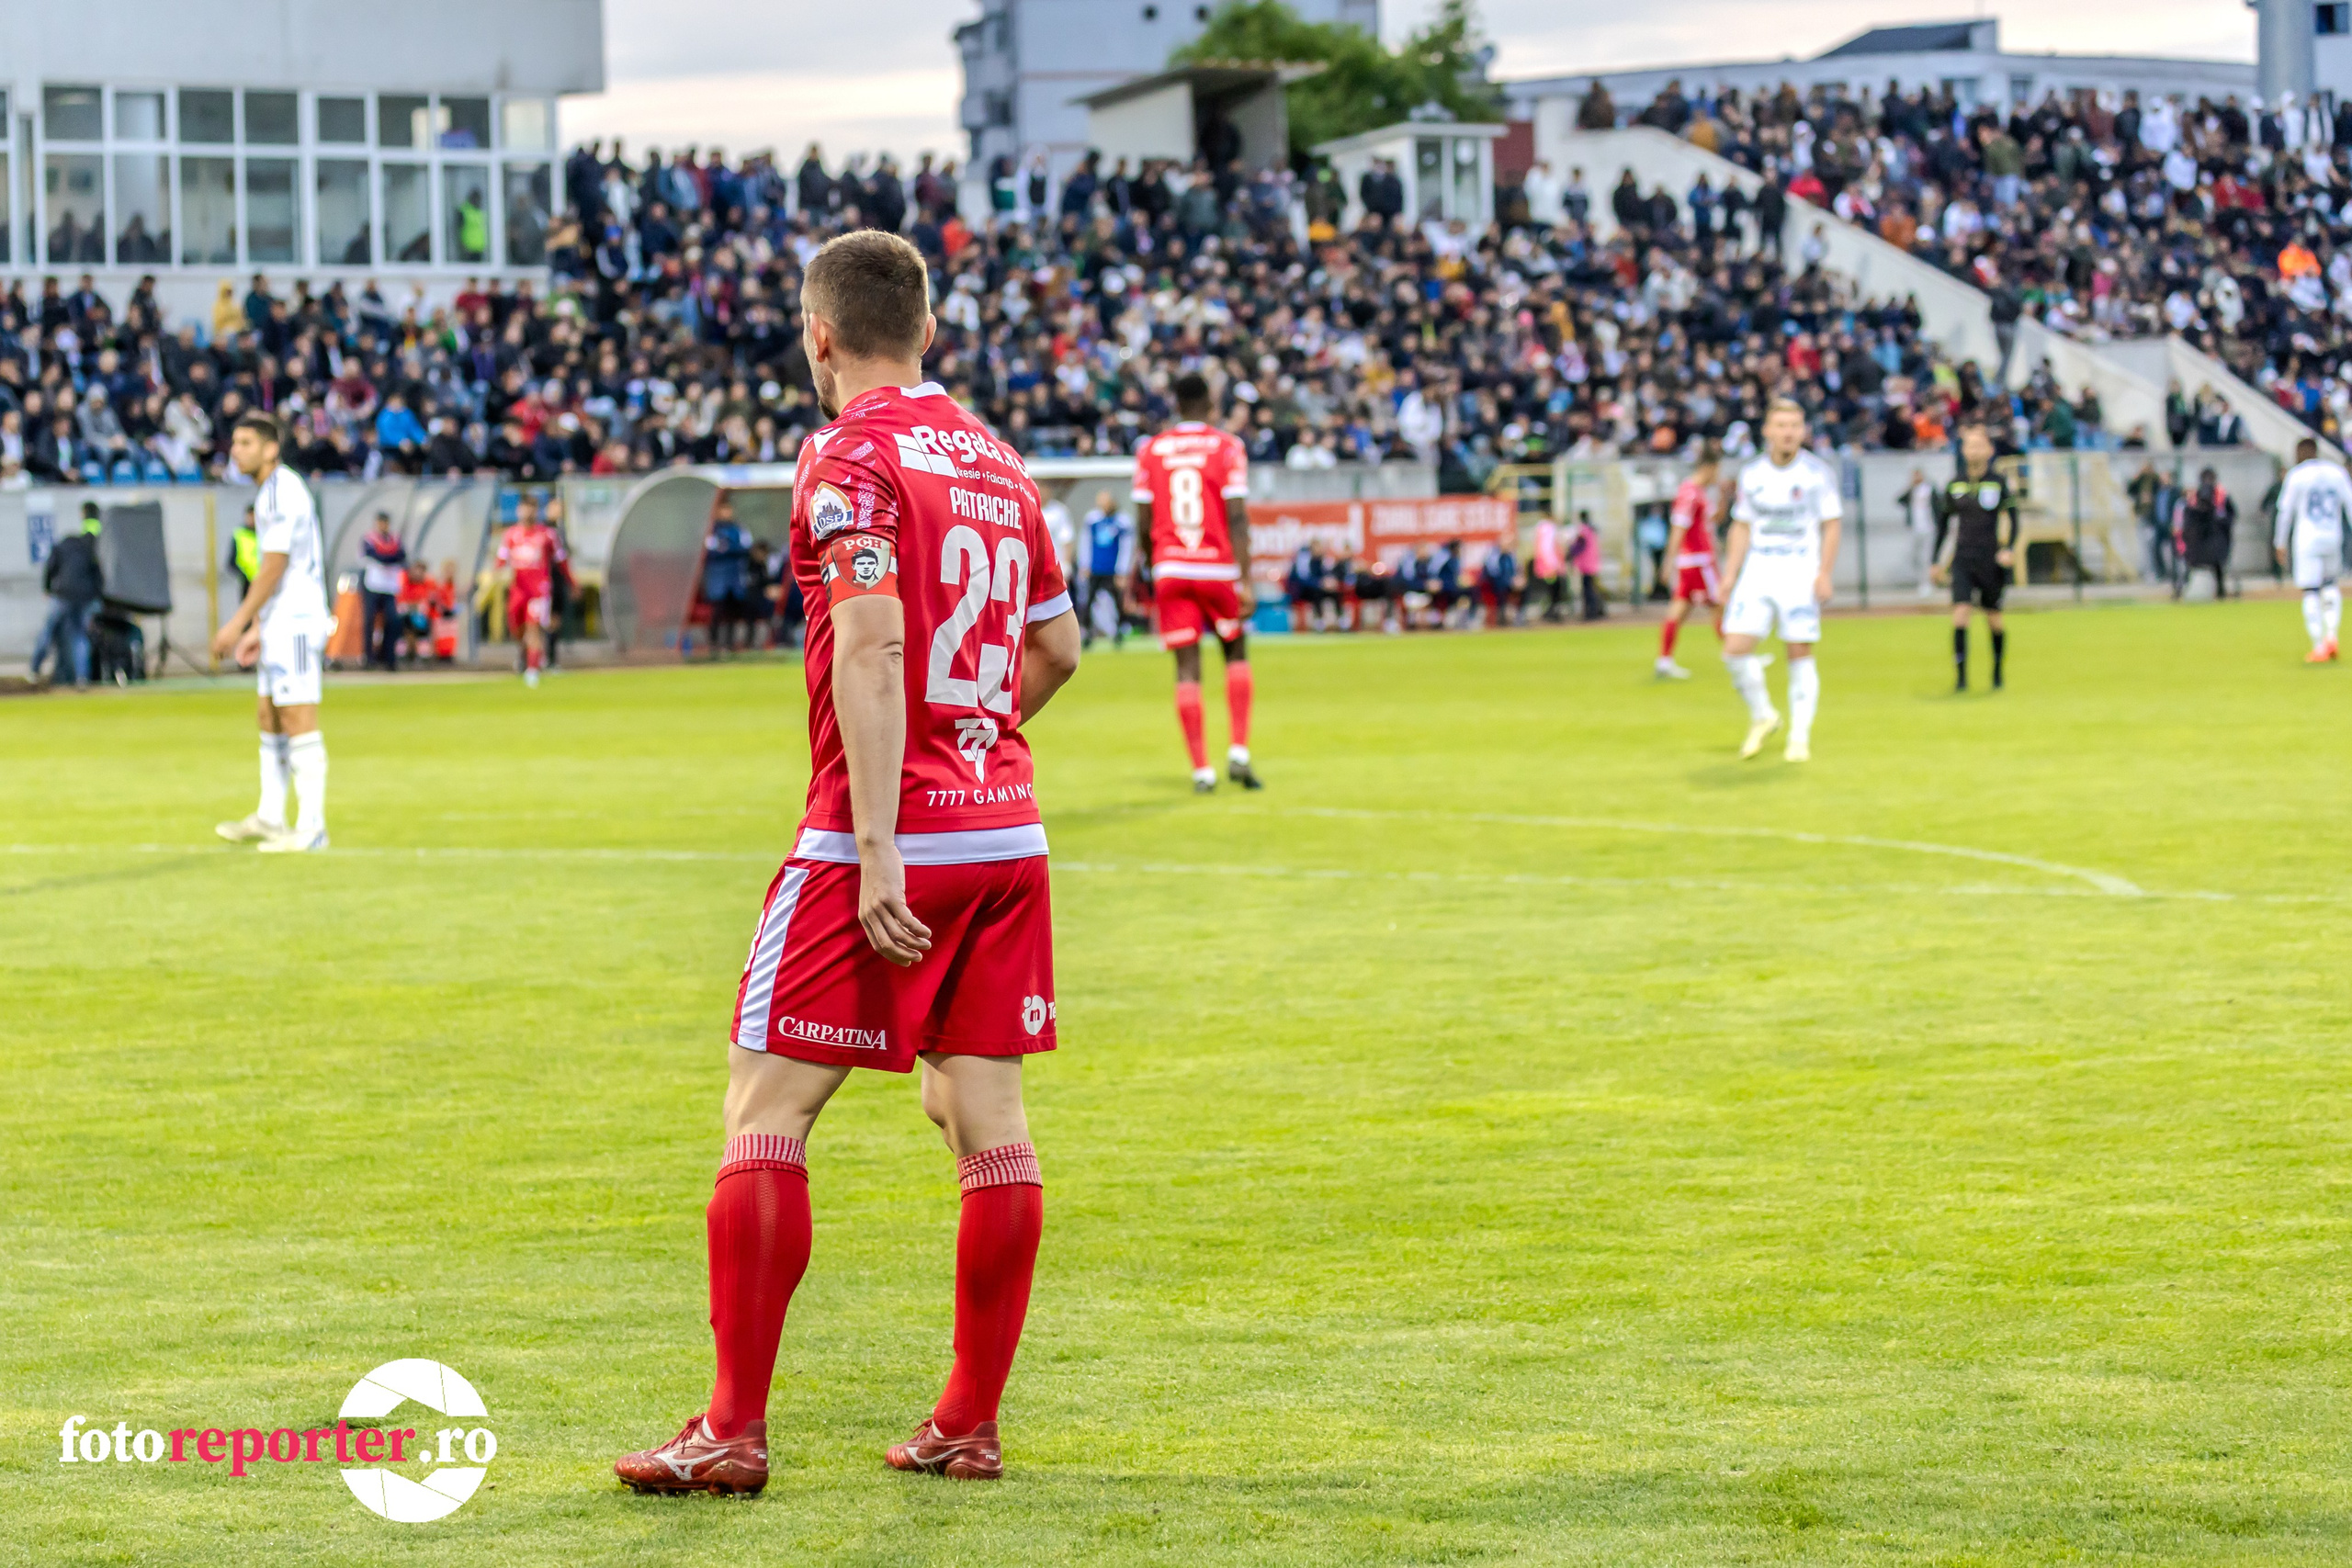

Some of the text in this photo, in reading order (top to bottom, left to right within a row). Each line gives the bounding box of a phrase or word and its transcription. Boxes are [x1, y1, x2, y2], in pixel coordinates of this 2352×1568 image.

[910, 425, 1030, 479] Regata.ro
[956, 467, 981, 479] Gresie
[949, 486, 1023, 530] PATRICHE
[1170, 468, 1204, 527] 8
[819, 514, 842, 529] DSF
[842, 536, 883, 551] PCH
[924, 525, 1029, 715] 23
[927, 790, 966, 807] 7777
[778, 1016, 887, 1050] CARPATINA
